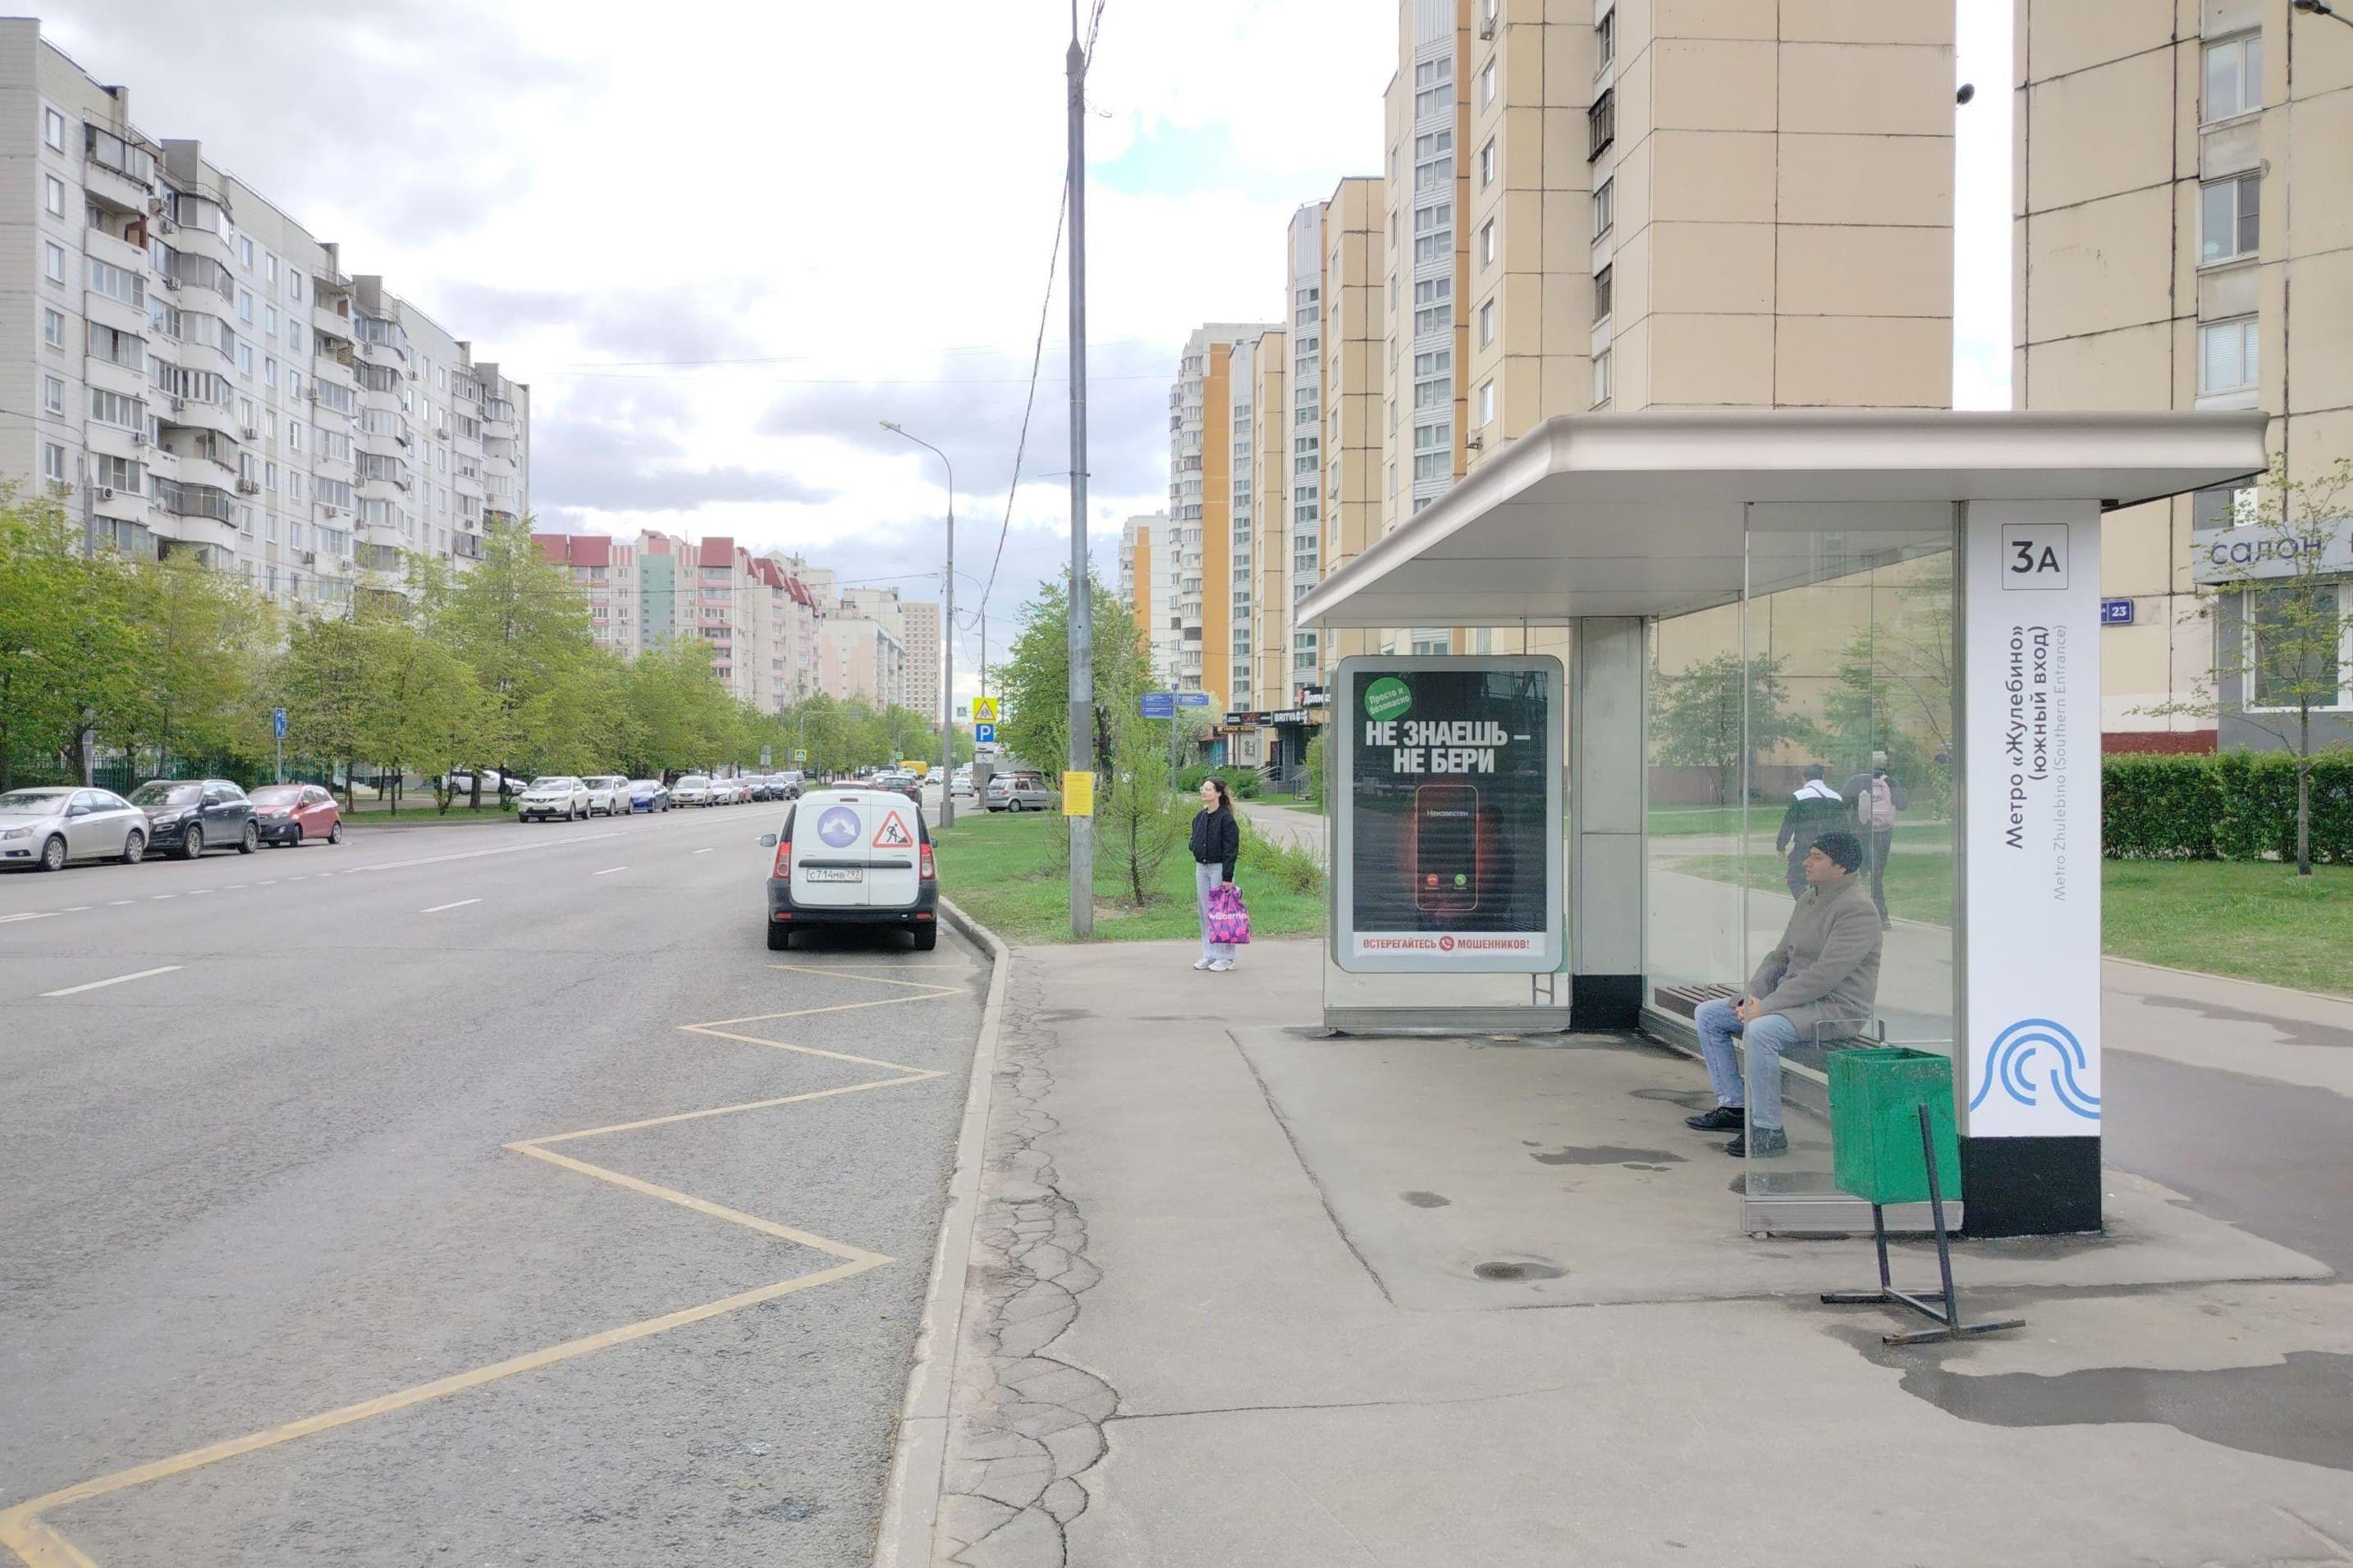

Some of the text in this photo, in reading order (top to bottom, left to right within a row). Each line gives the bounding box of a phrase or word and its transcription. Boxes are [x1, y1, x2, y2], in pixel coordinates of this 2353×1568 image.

[2211, 537, 2322, 565] салон
[2112, 606, 2127, 617] 23
[1369, 689, 1397, 704] Просто
[1369, 695, 1410, 715] безопасно
[2028, 626, 2049, 780] (южный вход)
[980, 725, 991, 741] P
[1366, 721, 1398, 746] НЕ
[1403, 720, 1508, 746] ЗНАЕШЬ
[2005, 625, 2028, 850] Метро «Жулебино»
[1394, 748, 1495, 773] НЕ БЕРИ
[2053, 624, 2067, 902] Metro Zhulebino (Southern Entrance)
[1363, 938, 1530, 949] ОСТЕРЕГАЙТЕСЬ МОШЕННИКОВ!
